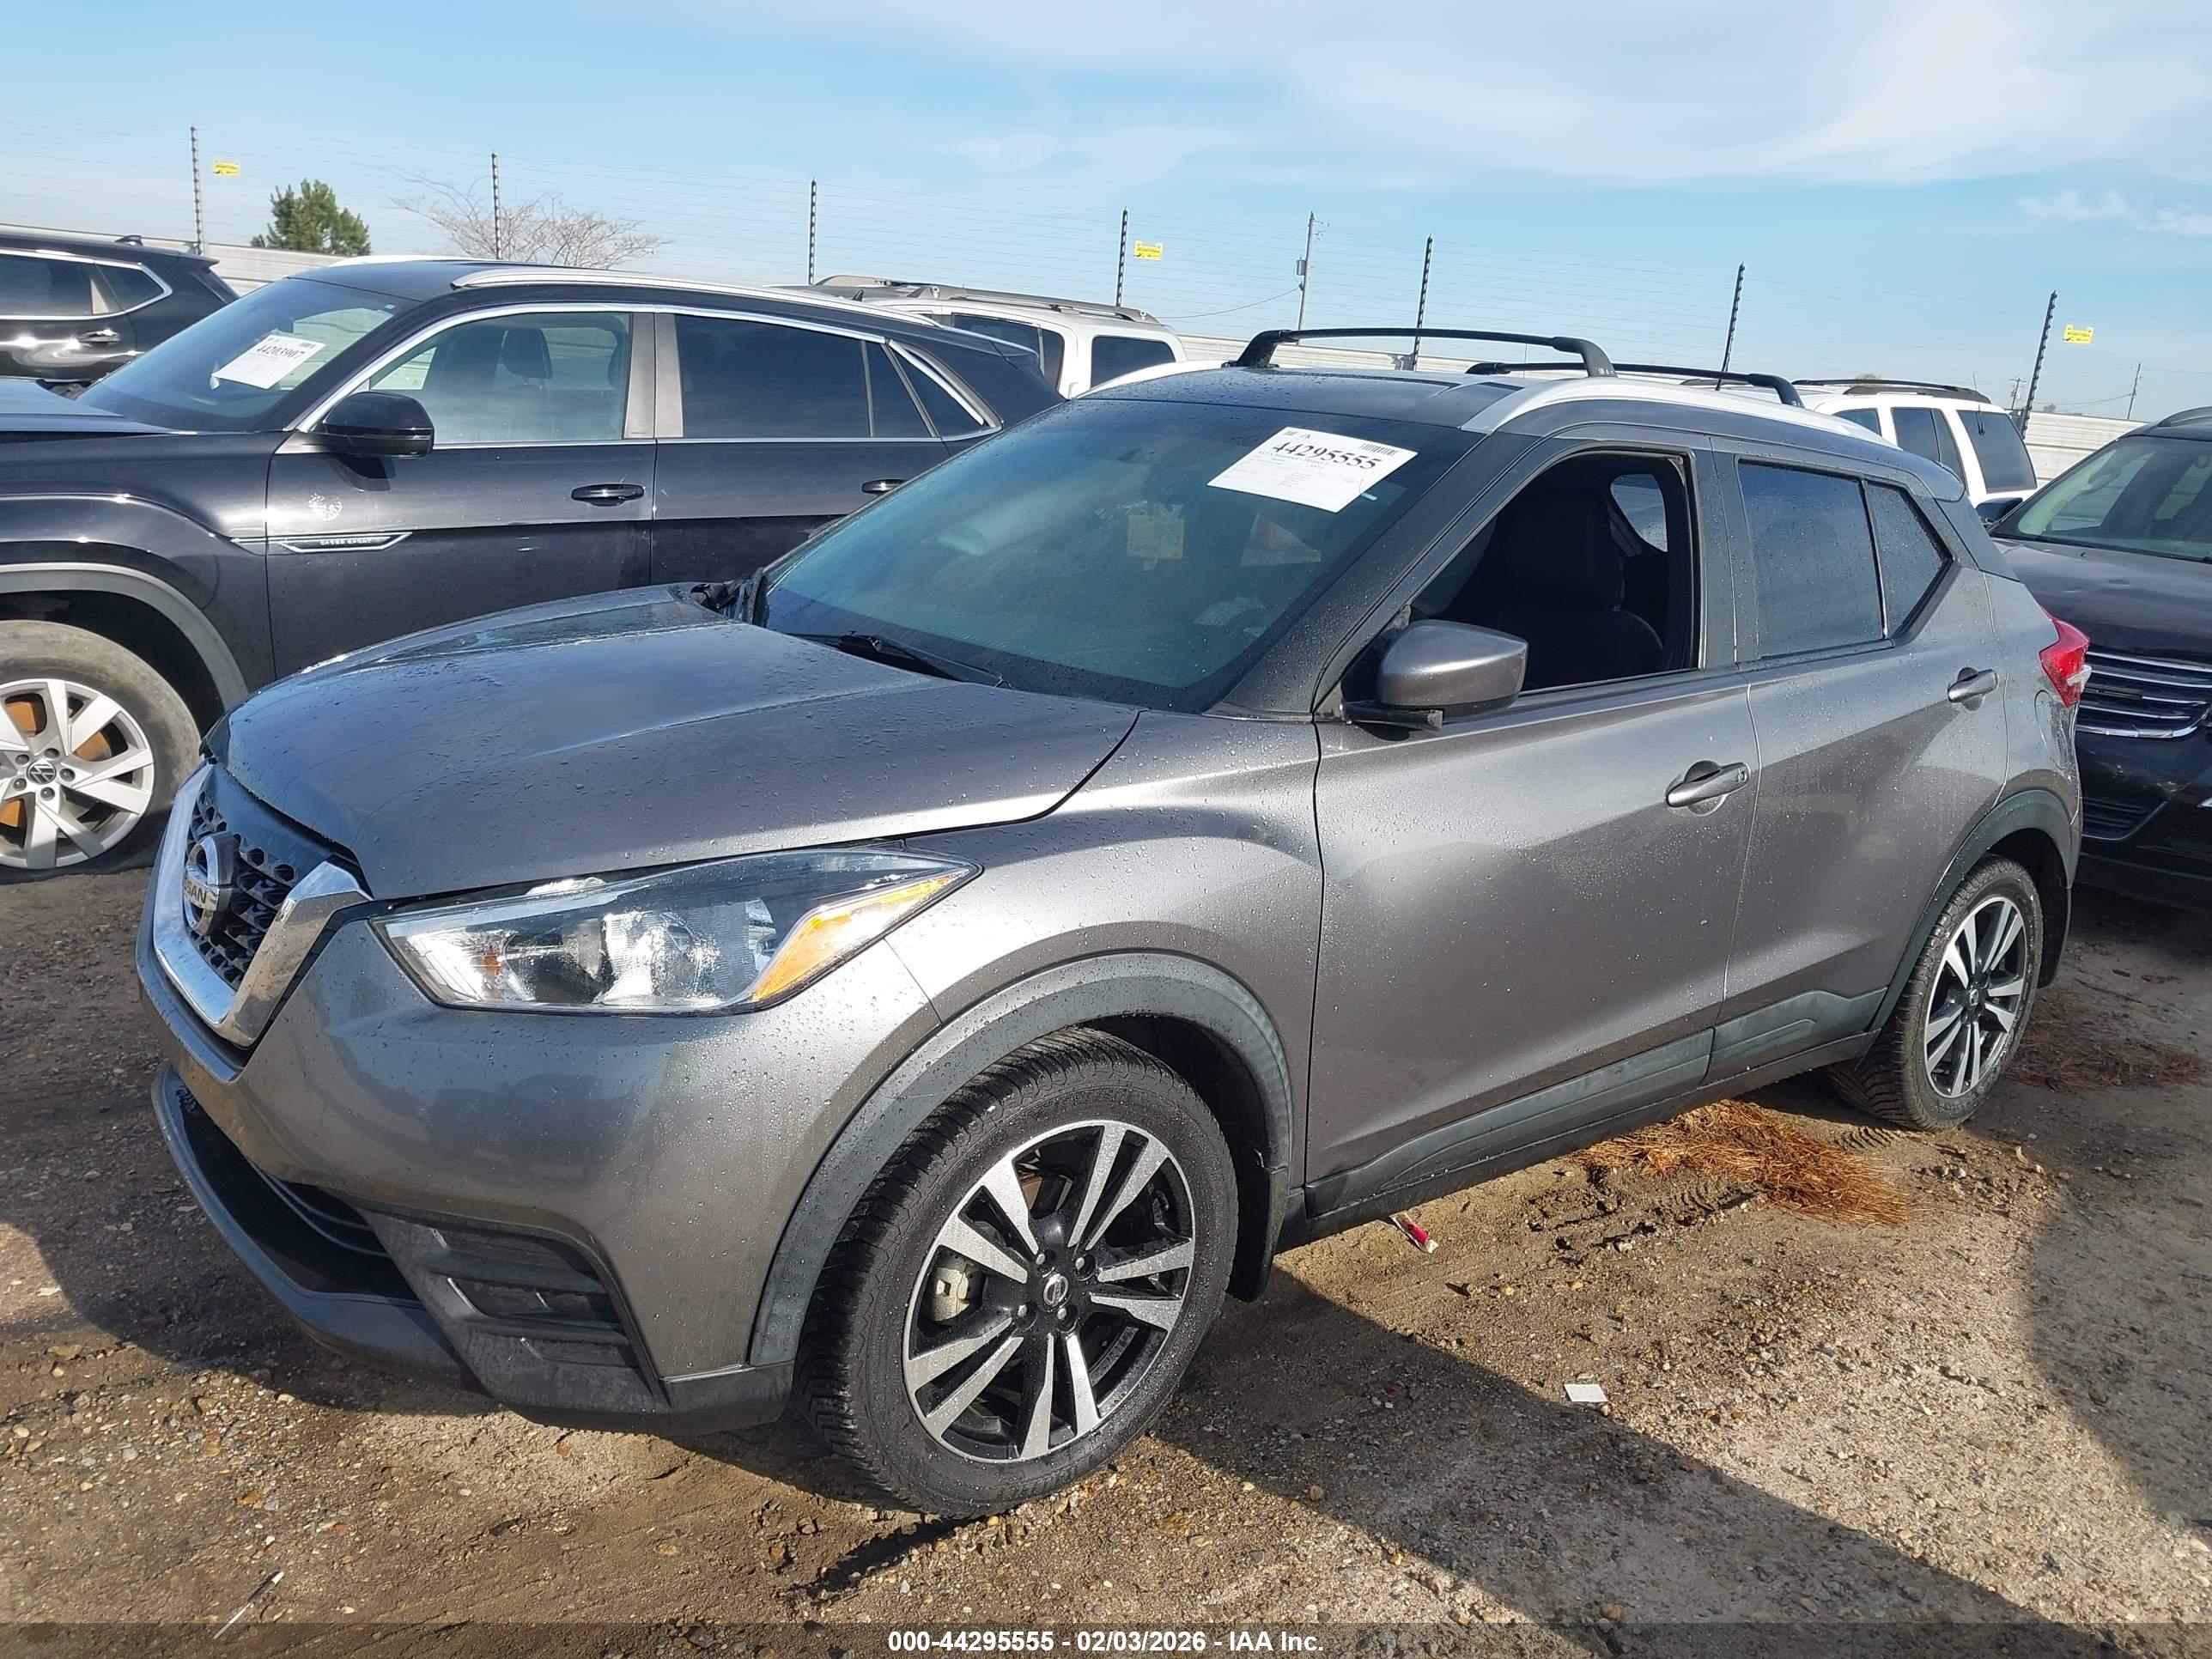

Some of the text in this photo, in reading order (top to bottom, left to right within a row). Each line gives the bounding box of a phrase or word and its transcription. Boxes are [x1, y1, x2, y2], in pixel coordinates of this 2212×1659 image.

[256, 344, 306, 359] 44203907
[1272, 441, 1382, 470] 44295555
[183, 879, 207, 904] SAN
